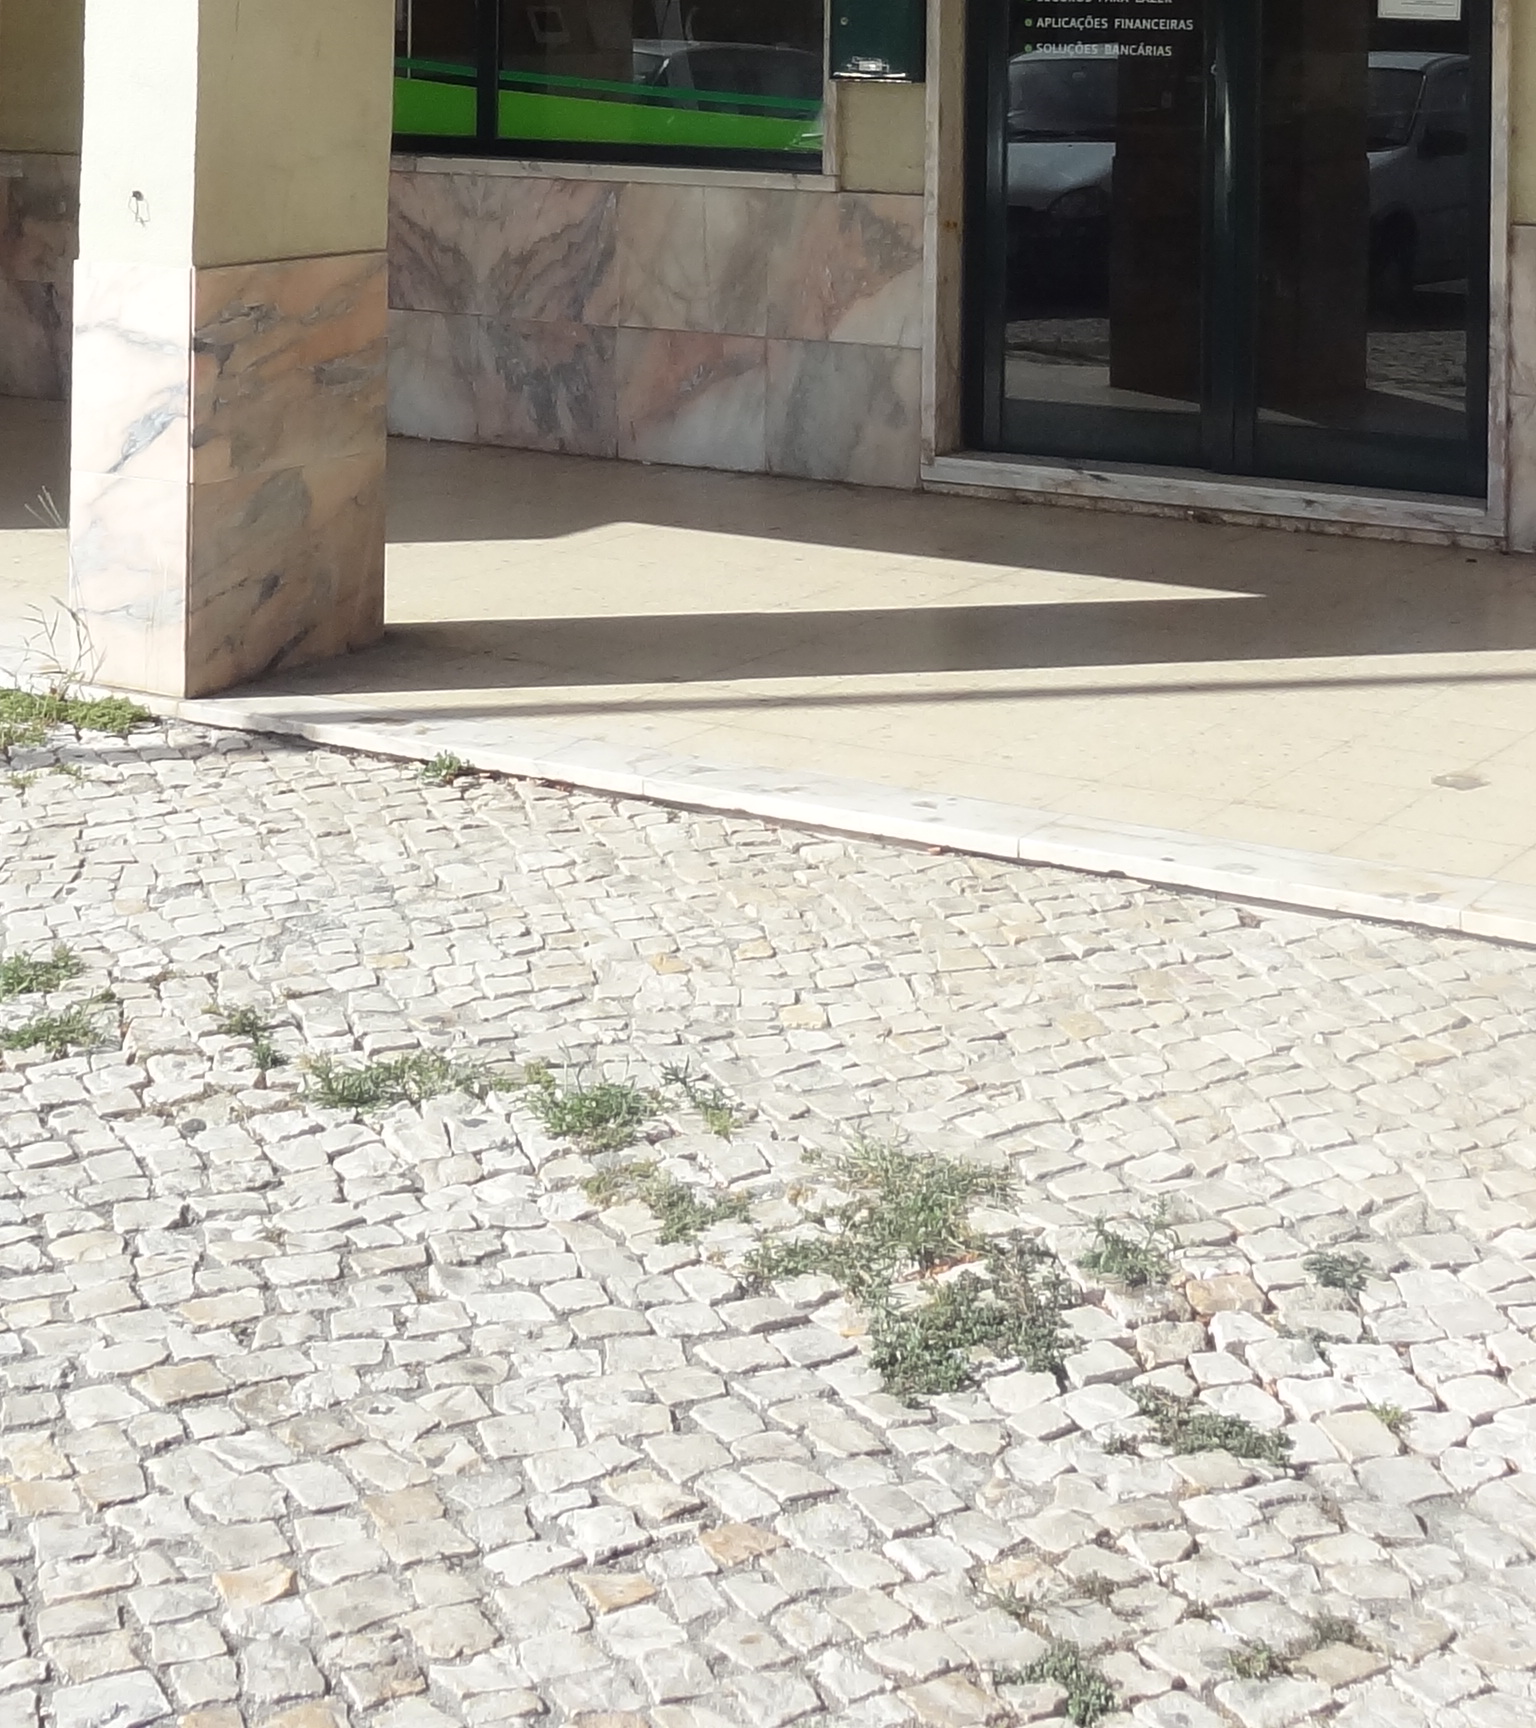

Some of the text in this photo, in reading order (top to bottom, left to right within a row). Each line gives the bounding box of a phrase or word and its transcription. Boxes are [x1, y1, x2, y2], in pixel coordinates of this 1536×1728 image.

[1036, 15, 1194, 31] APLICAÇÕES FINANCEIRAS
[1036, 41, 1172, 56] SOLUÇÕES BANCÁRIAS
